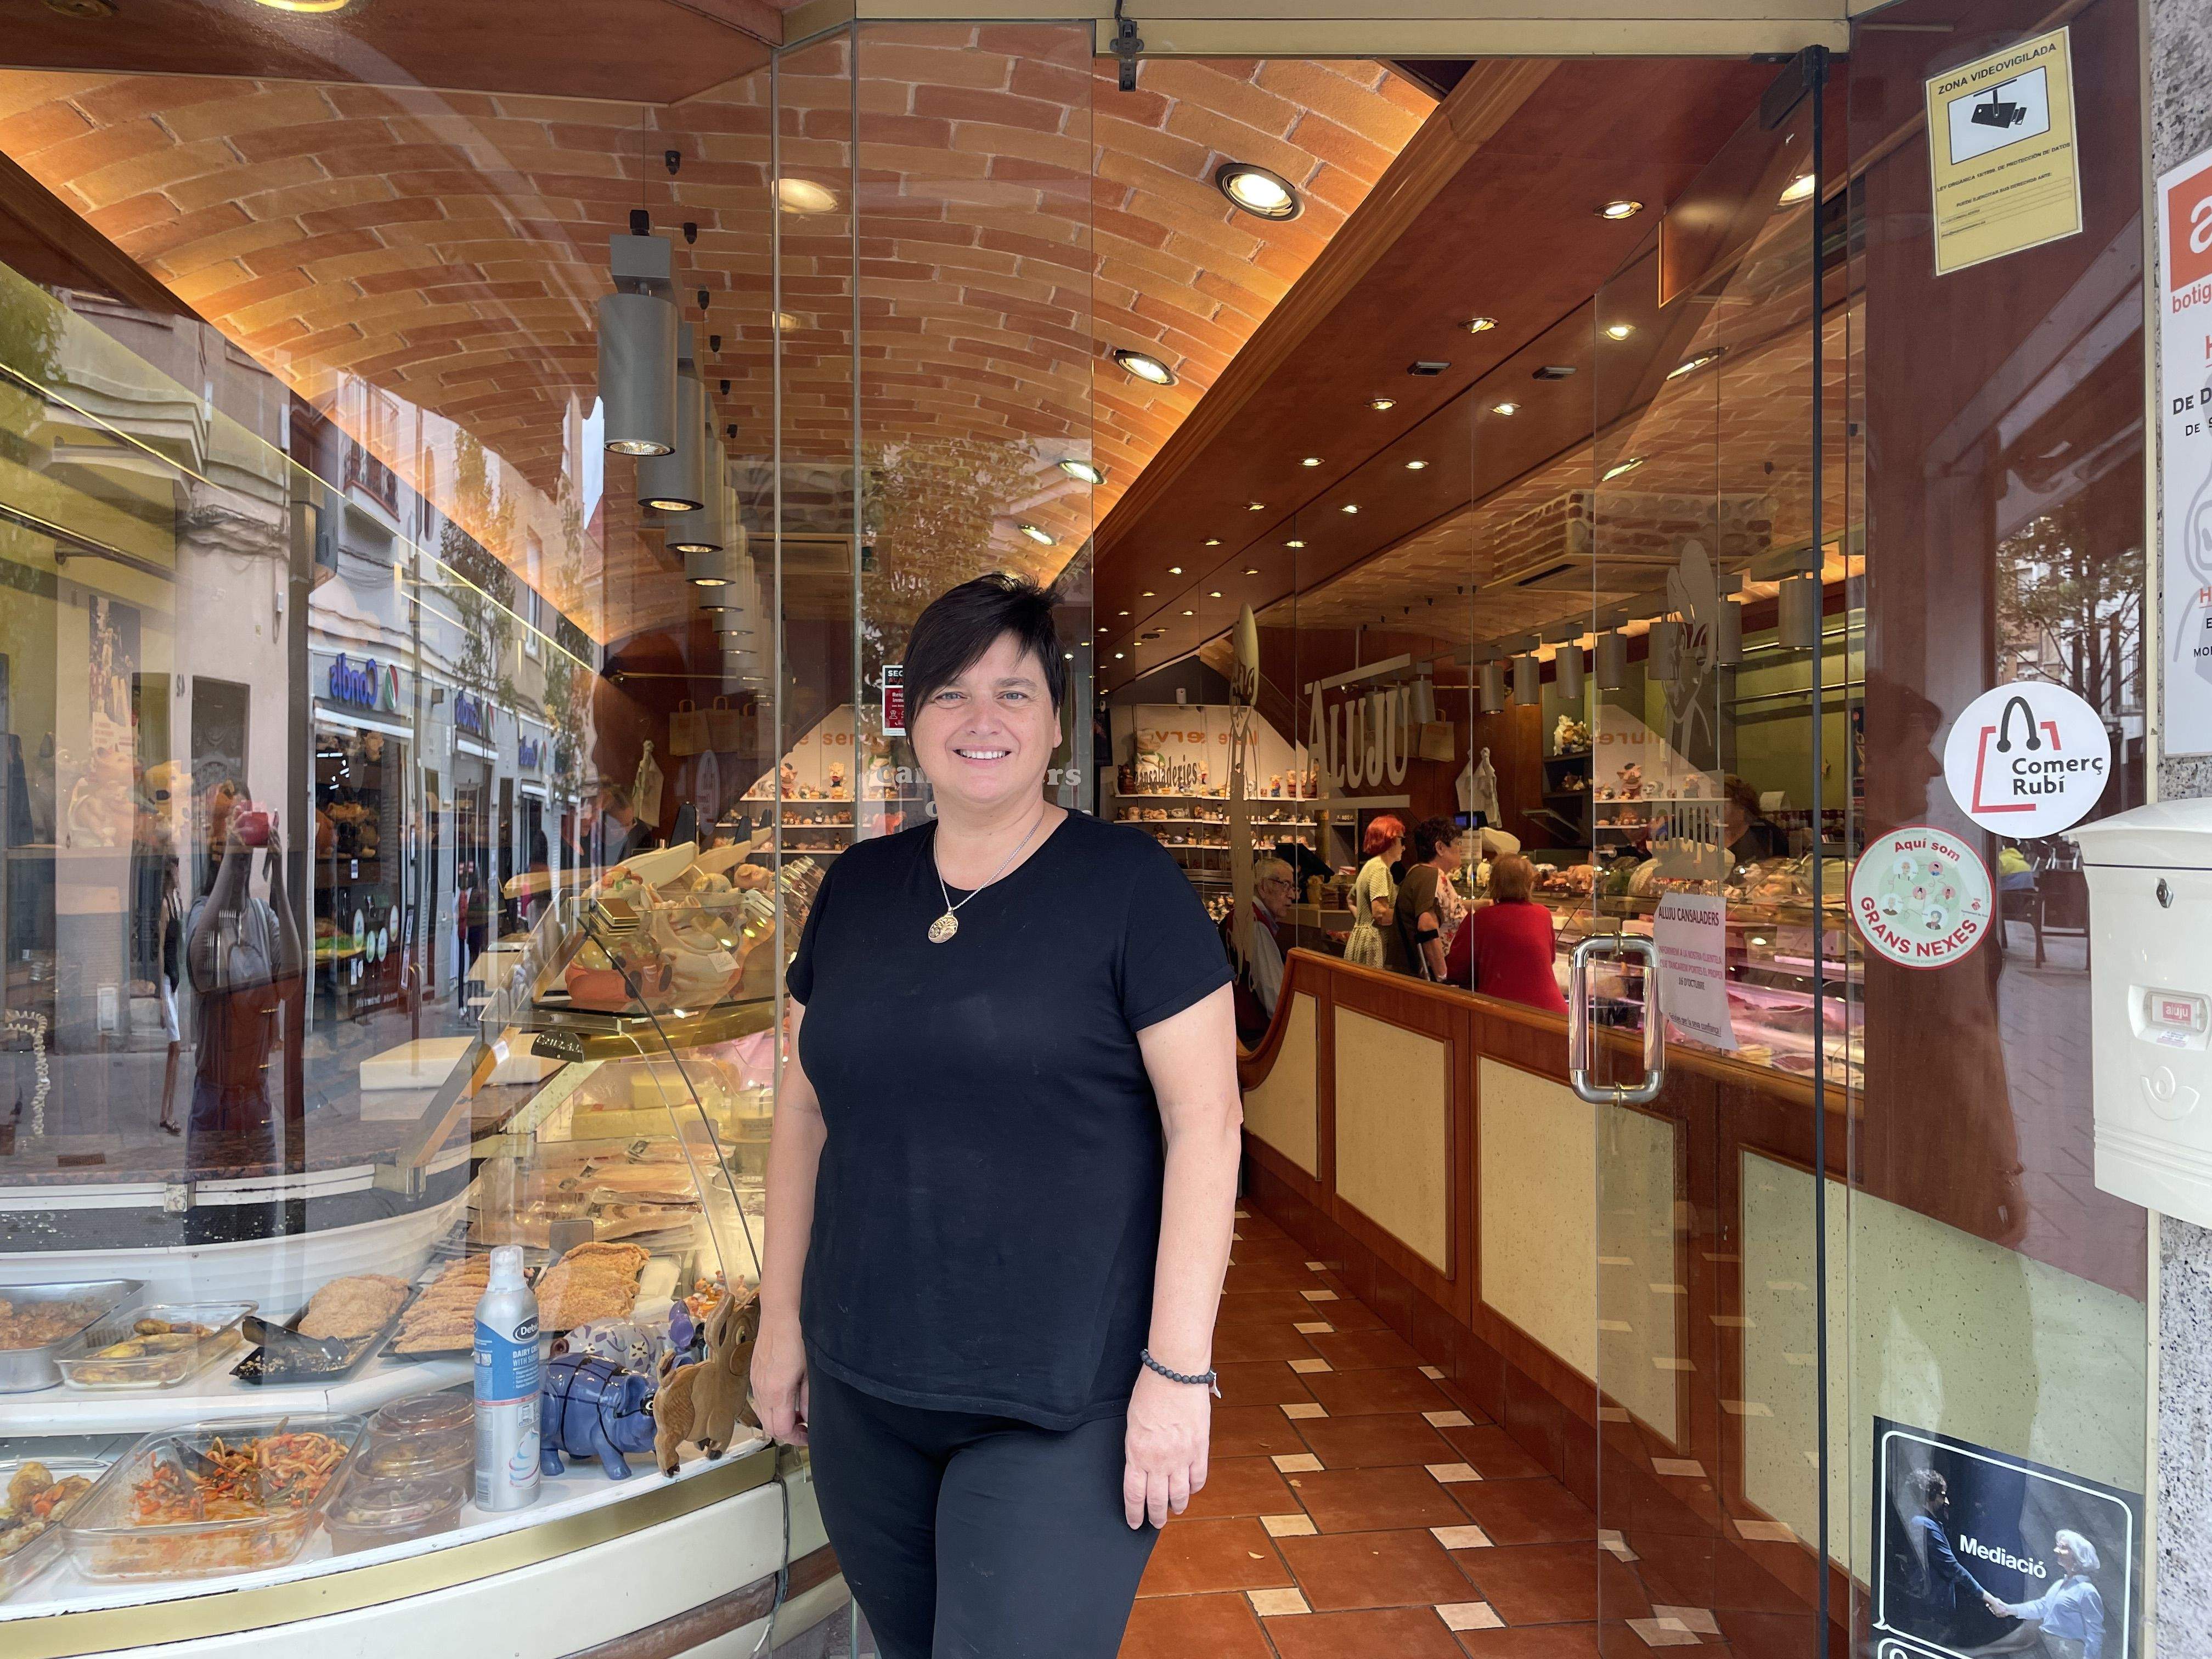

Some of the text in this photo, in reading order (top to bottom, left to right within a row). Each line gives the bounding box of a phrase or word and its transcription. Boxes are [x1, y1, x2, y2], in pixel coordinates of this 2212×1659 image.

[1938, 43, 2056, 95] ZONA VIDEOVIGILADA
[2051, 143, 2070, 153] DATOS
[2173, 394, 2194, 415] DE
[2185, 423, 2200, 436] DE
[1304, 680, 1410, 797] ALUJU
[2012, 758, 2103, 775] Comerç
[2013, 775, 2065, 795] Rubí
[1895, 838, 1927, 853] Aquí
[1931, 842, 1961, 862] som
[1658, 906, 1719, 927] ALUJU CANSALADERS
[1861, 897, 1977, 957] GRANS NEXES
[2166, 1004, 2188, 1019] aluju
[512, 1346, 531, 1358] DAIRY
[512, 1358, 527, 1367] WITH
[1960, 1534, 2047, 1579] Mediació
